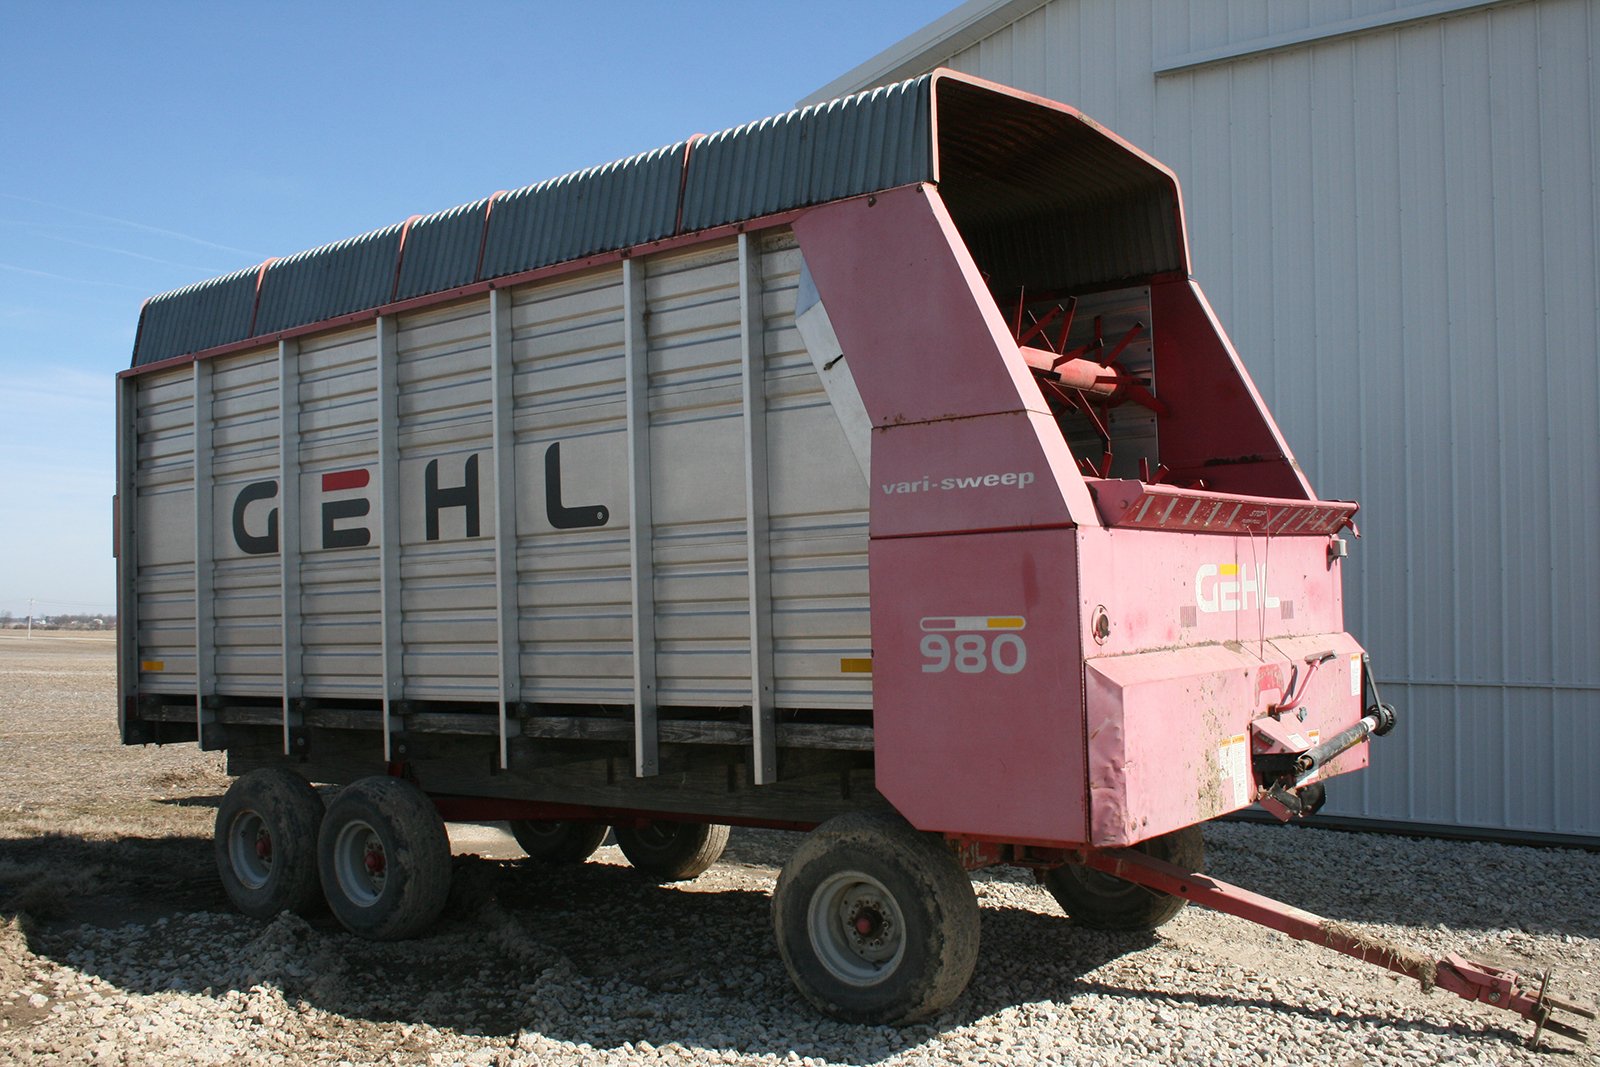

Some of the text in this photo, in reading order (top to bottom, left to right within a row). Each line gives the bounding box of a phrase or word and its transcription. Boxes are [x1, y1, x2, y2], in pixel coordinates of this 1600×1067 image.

[232, 442, 609, 555] GEHL
[882, 471, 1035, 495] vari-sweep
[1195, 562, 1280, 612] GEHL
[919, 633, 1027, 675] 980
